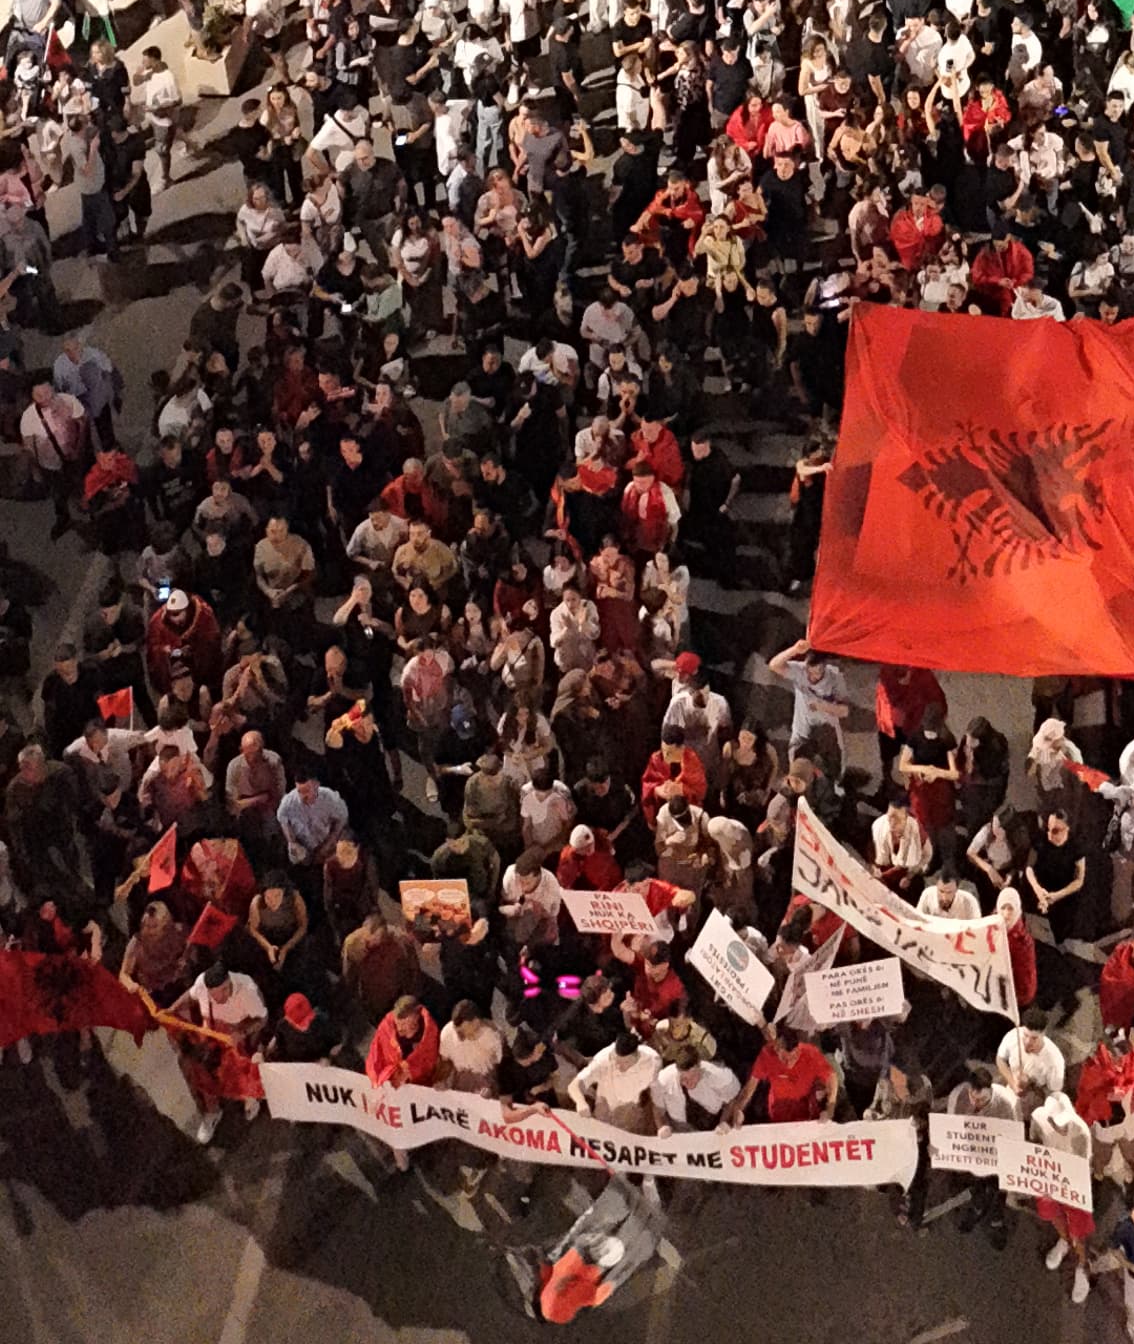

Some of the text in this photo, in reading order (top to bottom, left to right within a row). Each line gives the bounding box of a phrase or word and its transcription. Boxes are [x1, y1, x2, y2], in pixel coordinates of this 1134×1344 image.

[590, 901, 624, 911] RINI
[822, 972, 847, 980] PARA
[829, 1000, 847, 1009] PAS
[851, 1005, 885, 1017] SHESH
[304, 1082, 357, 1108] NUK
[361, 1093, 369, 1113] I
[410, 1102, 470, 1130] LARË
[478, 1119, 562, 1154] AKOMA
[570, 1136, 677, 1167] HESAPET
[687, 1151, 723, 1169] ME
[730, 1134, 876, 1170] STUDENTËT
[964, 1121, 987, 1130] KUR
[946, 1131, 998, 1143] STUDENT
[952, 1143, 998, 1154] NGRIHE
[1034, 1147, 1051, 1156] PA
[1026, 1155, 1061, 1173] RINI
[1020, 1165, 1070, 1185] NUK KA
[1006, 1174, 1086, 1205] SHQIPËRI
